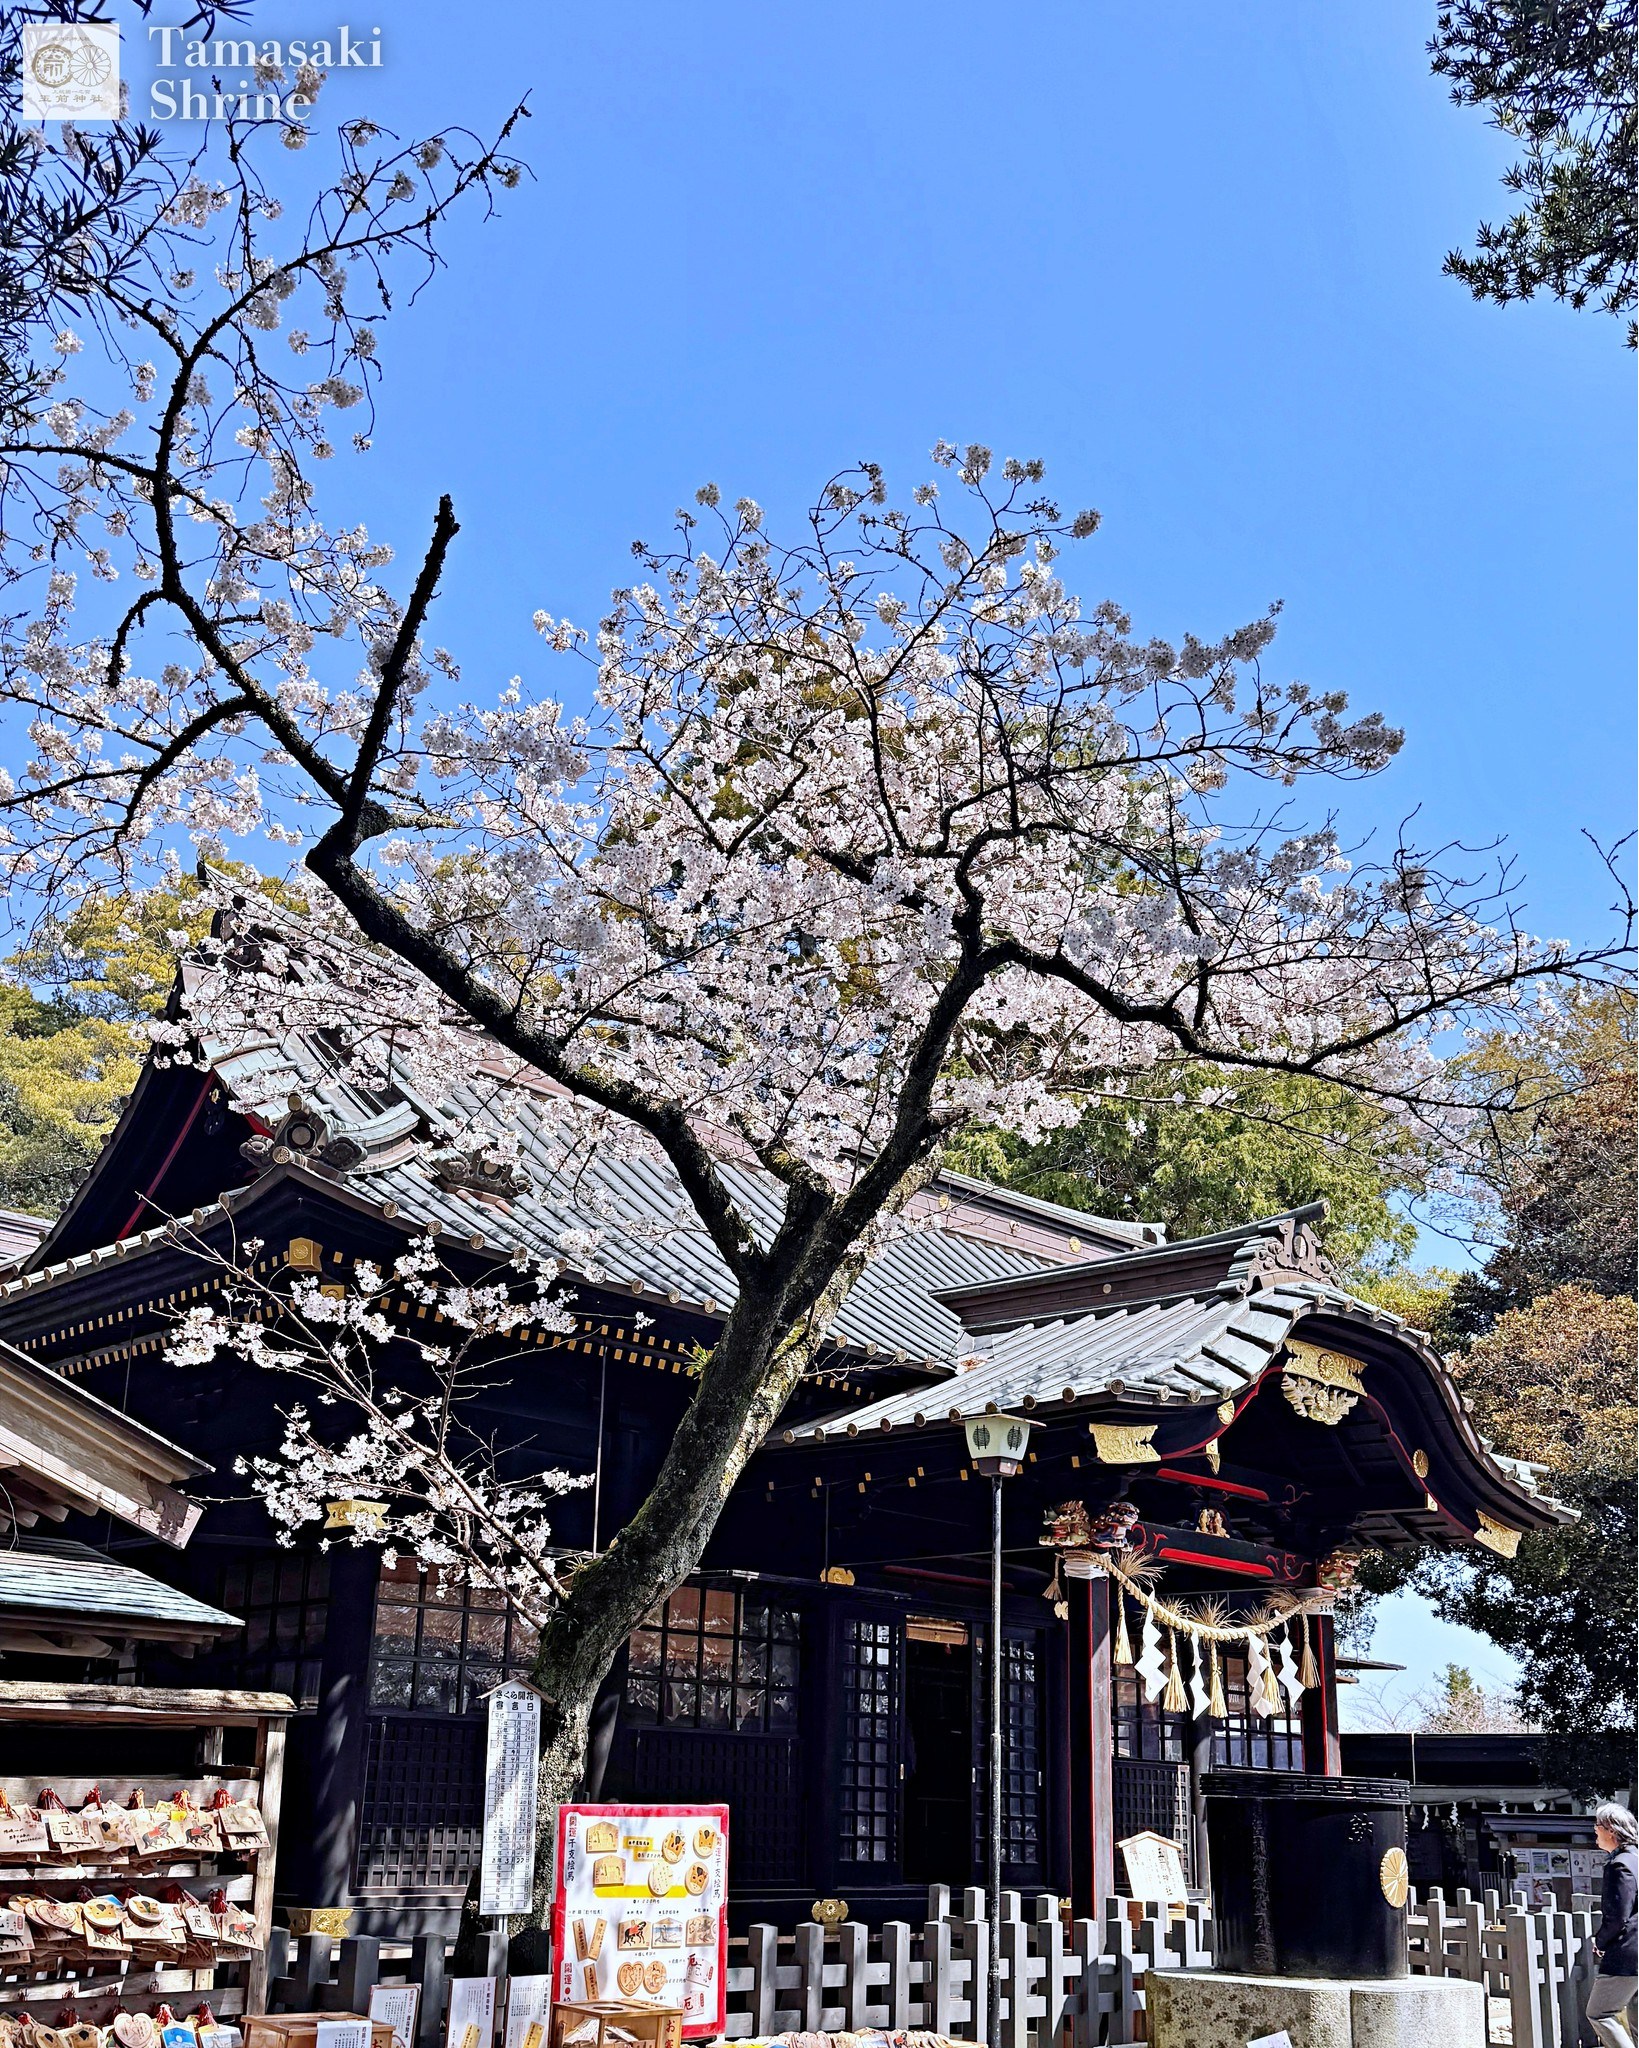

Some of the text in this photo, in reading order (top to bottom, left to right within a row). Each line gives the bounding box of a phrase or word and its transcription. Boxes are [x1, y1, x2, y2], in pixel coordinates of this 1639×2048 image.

[496, 1690, 534, 1701] さくら開花
